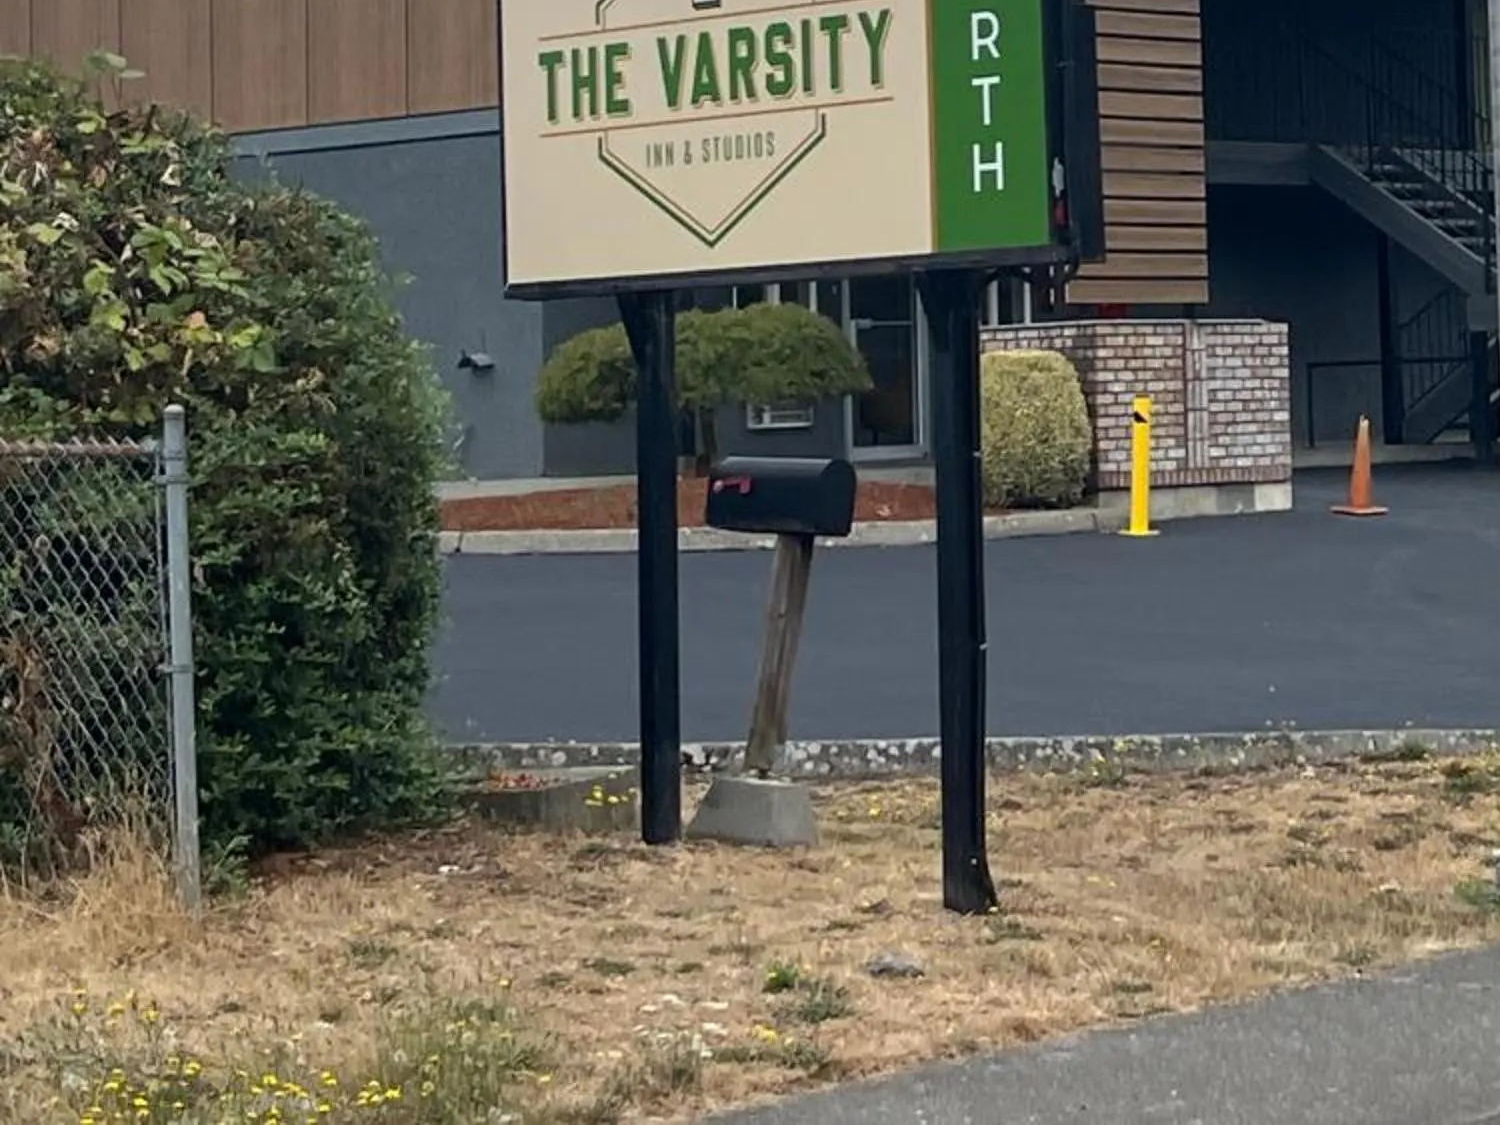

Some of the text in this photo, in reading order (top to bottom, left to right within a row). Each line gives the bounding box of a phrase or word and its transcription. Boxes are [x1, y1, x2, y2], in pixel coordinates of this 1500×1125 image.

[538, 8, 892, 123] THE VARSITY
[646, 131, 775, 168] INN & STUDIOS
